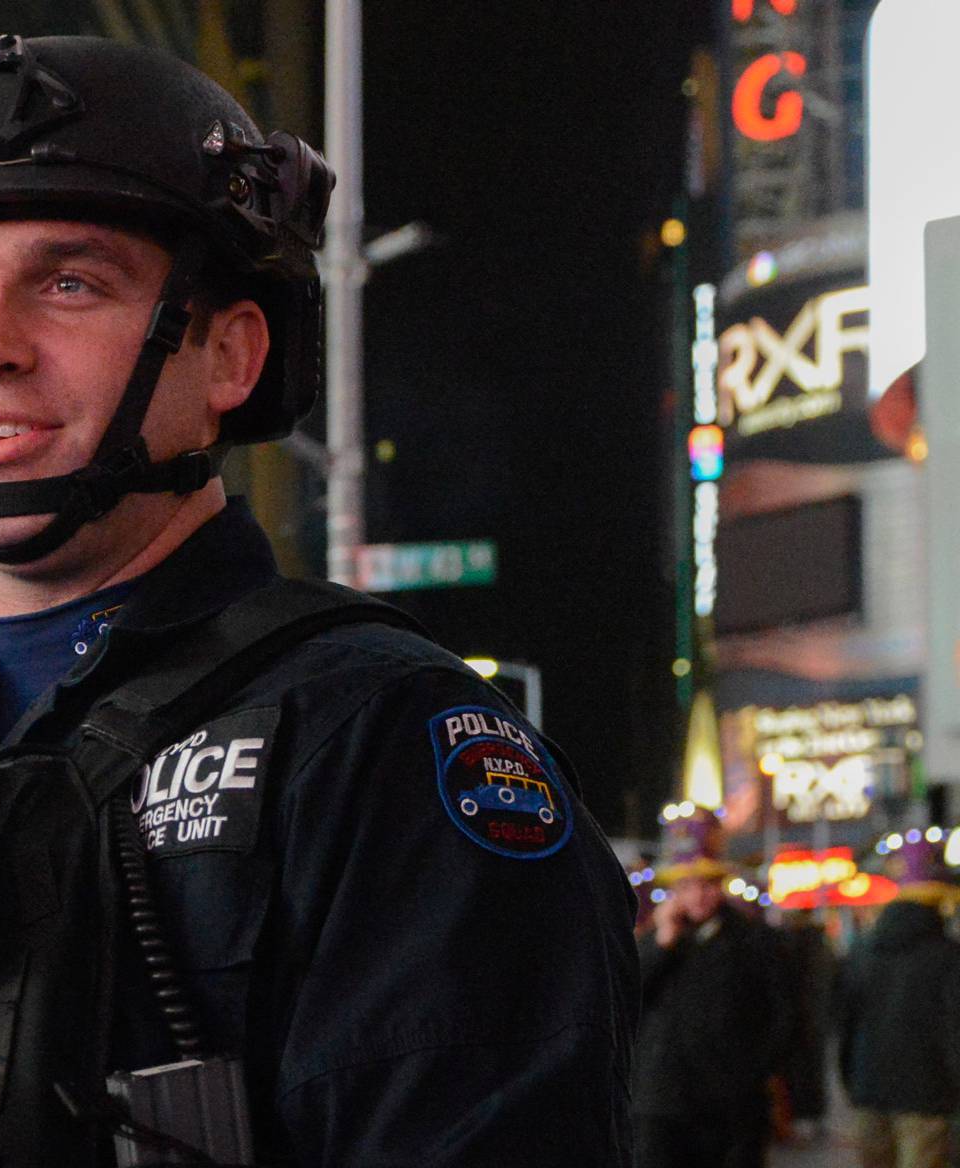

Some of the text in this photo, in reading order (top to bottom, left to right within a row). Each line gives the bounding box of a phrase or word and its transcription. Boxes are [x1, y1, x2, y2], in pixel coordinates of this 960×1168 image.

[446, 713, 539, 761] POLICE
[130, 738, 264, 813] OLICE
[140, 792, 220, 832] ERGENCY
[178, 816, 228, 842] UNIT
